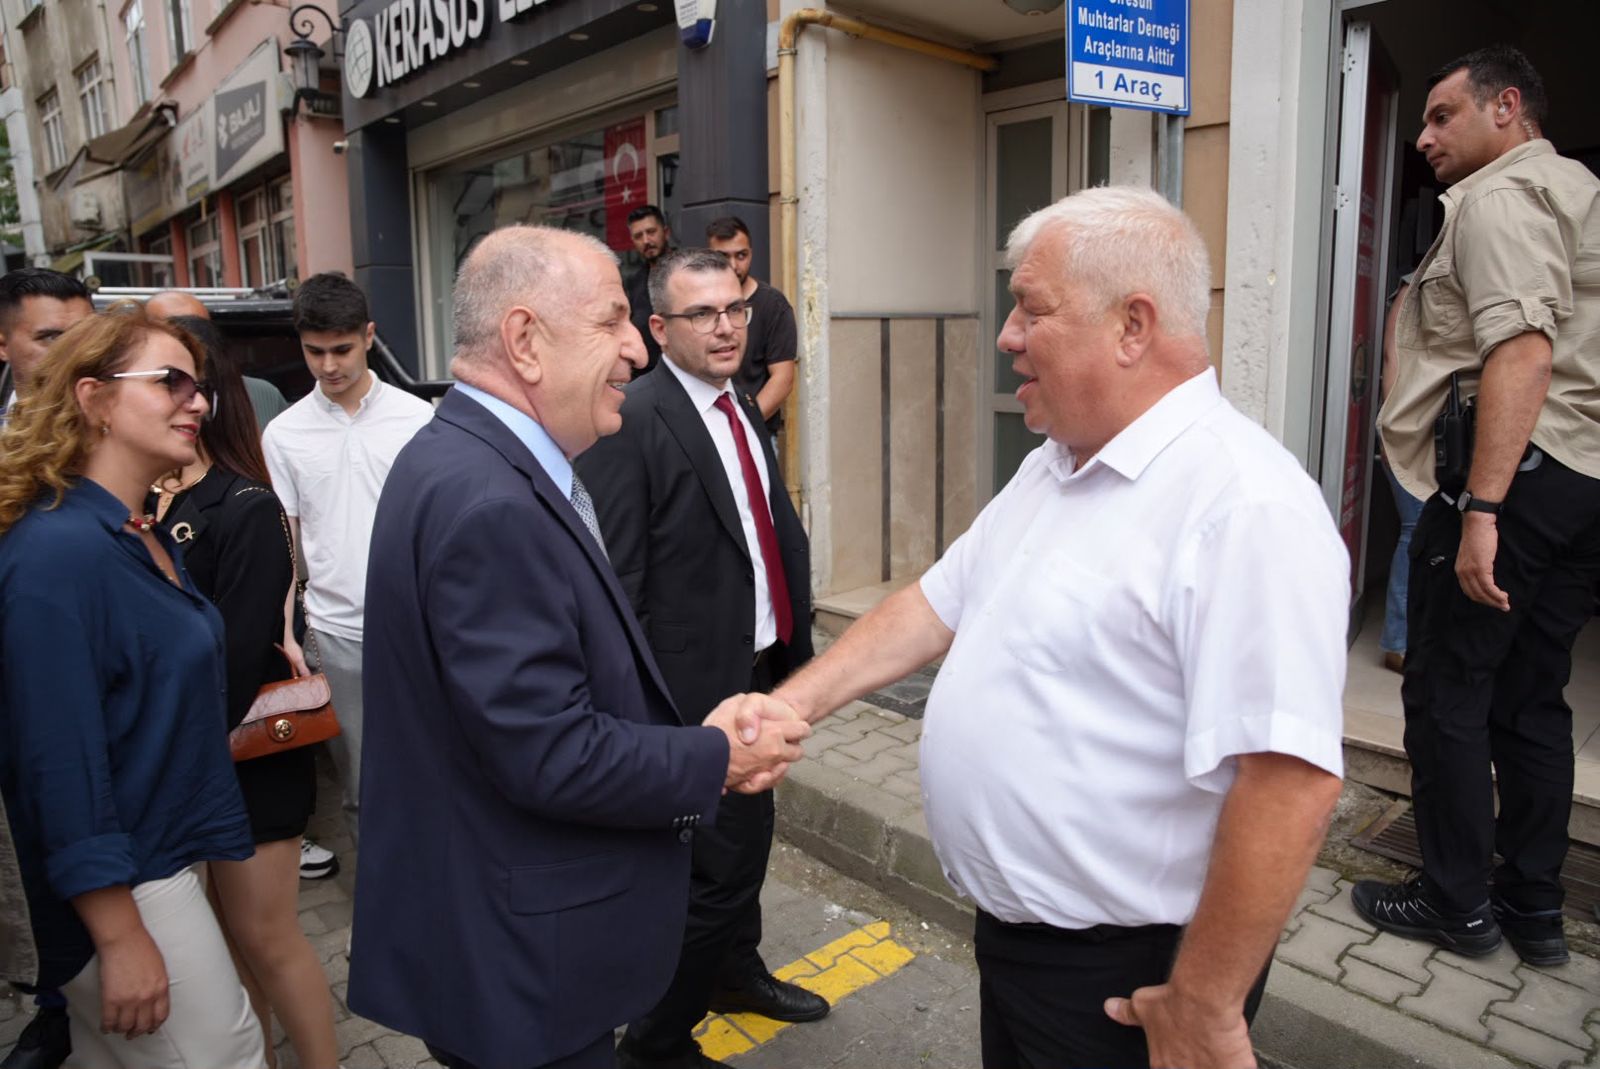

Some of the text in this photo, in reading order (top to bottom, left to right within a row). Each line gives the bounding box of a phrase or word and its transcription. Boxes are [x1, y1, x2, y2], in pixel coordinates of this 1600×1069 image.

[1078, 6, 1180, 45] Muhtarlar Derneği
[375, 0, 485, 88] KERASUS
[1084, 35, 1175, 66] Araçlarına Aittir
[1095, 70, 1163, 101] 1 Araç
